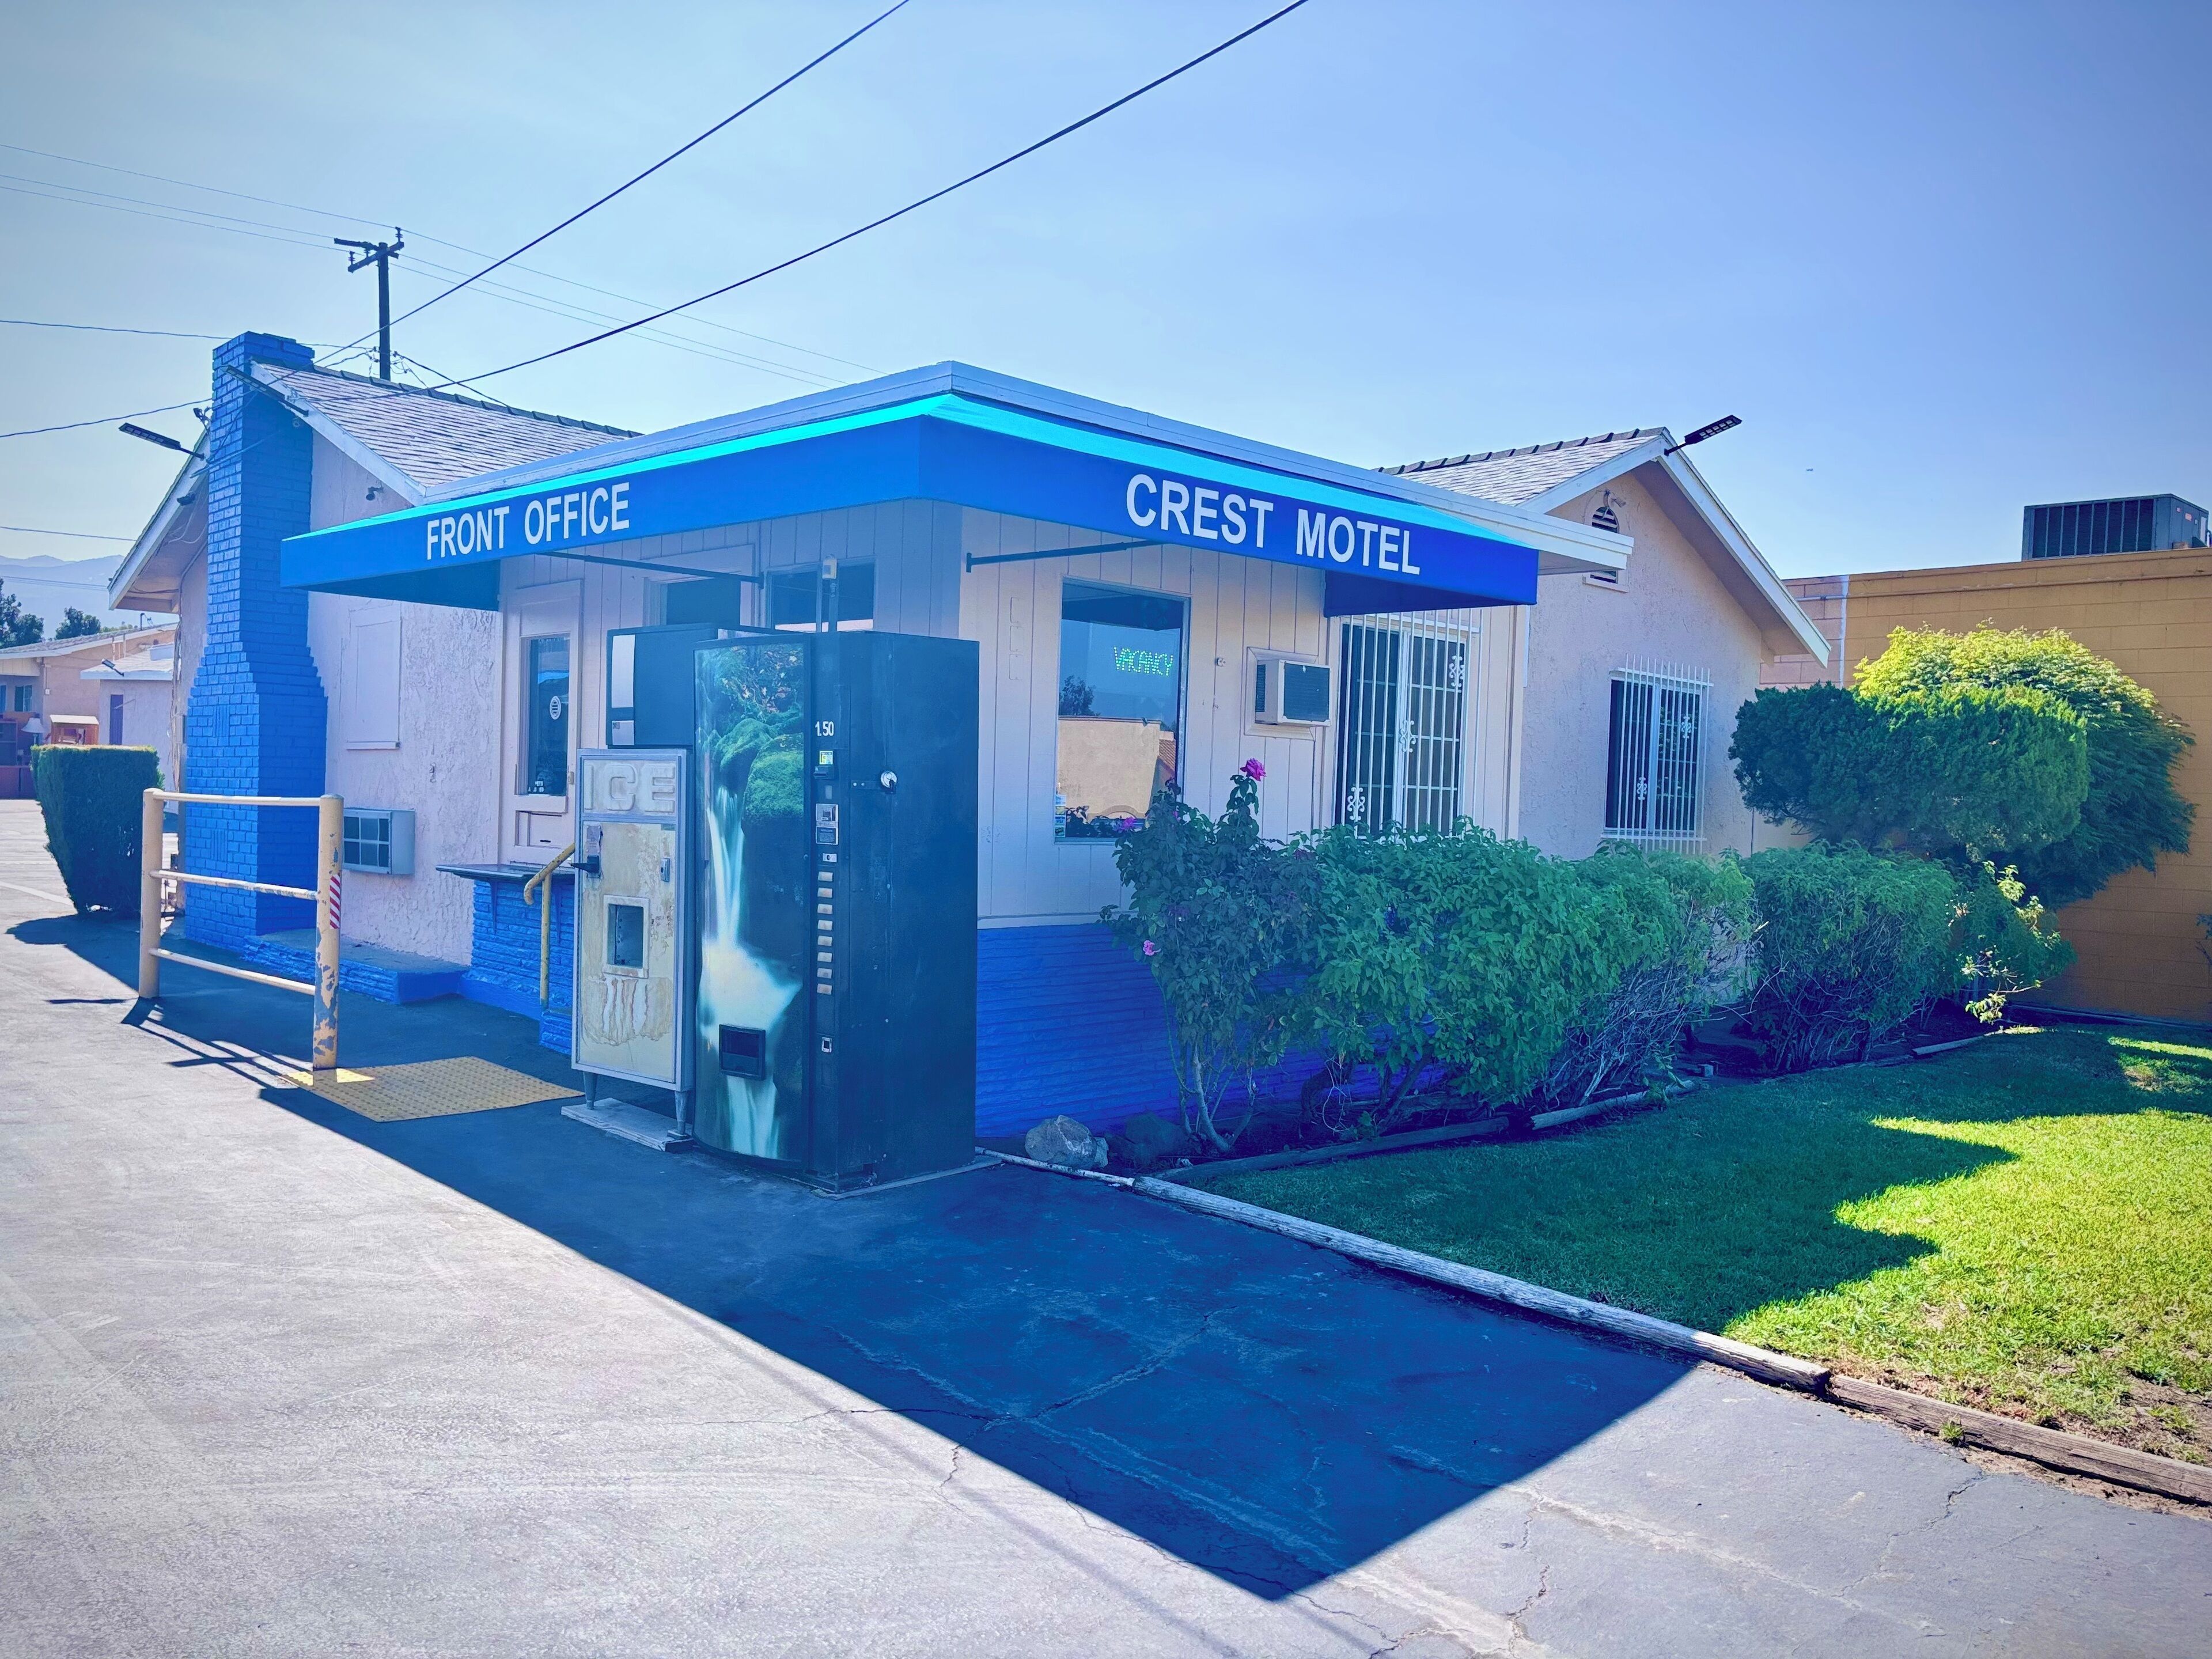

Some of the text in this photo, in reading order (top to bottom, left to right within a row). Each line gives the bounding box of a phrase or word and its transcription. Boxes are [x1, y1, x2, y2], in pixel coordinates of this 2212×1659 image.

[426, 482, 630, 560] FRONT OFFICE
[1126, 474, 1421, 575] CREST MOTEL
[1113, 646, 1173, 676] VACANCY
[815, 721, 835, 737] 1.50
[584, 763, 676, 813] ICE
